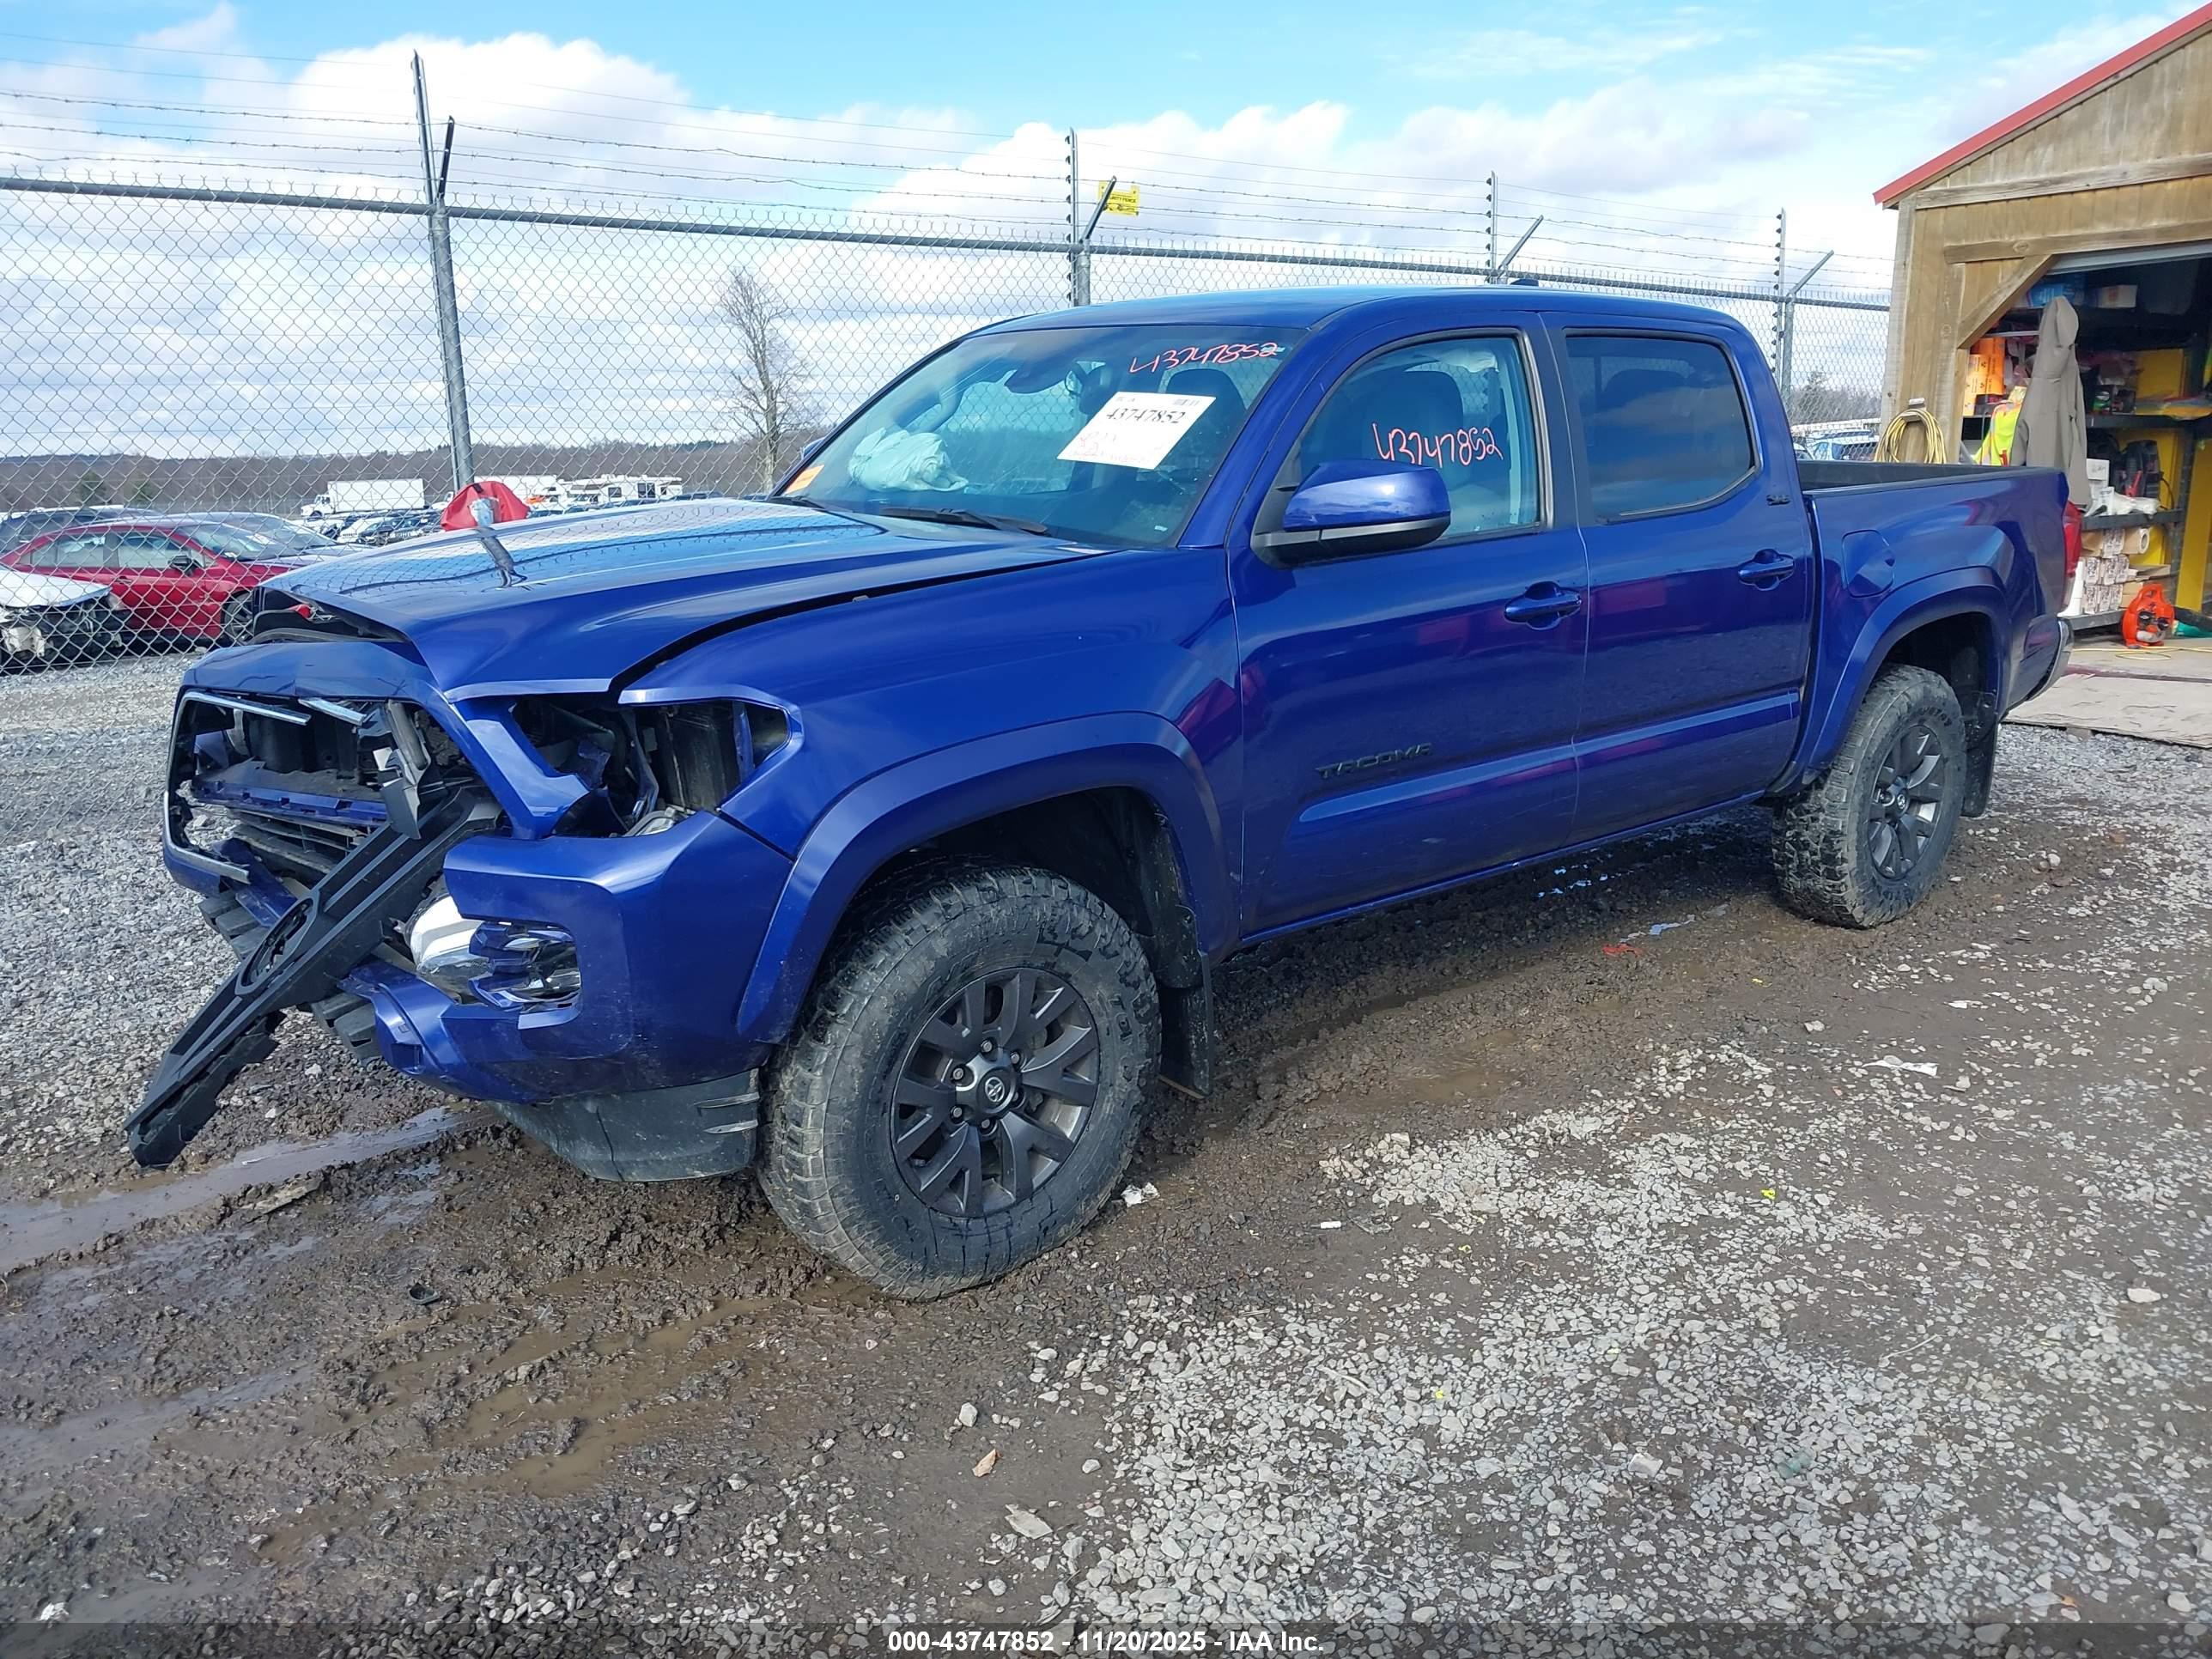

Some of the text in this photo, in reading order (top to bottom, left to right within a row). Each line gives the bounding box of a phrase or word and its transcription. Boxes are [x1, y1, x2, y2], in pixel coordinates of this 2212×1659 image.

[1128, 342, 1279, 374] 43747852
[1106, 407, 1187, 424] 43747852
[1372, 422, 1504, 469] 43747852
[1315, 742, 1433, 779] TACOMA
